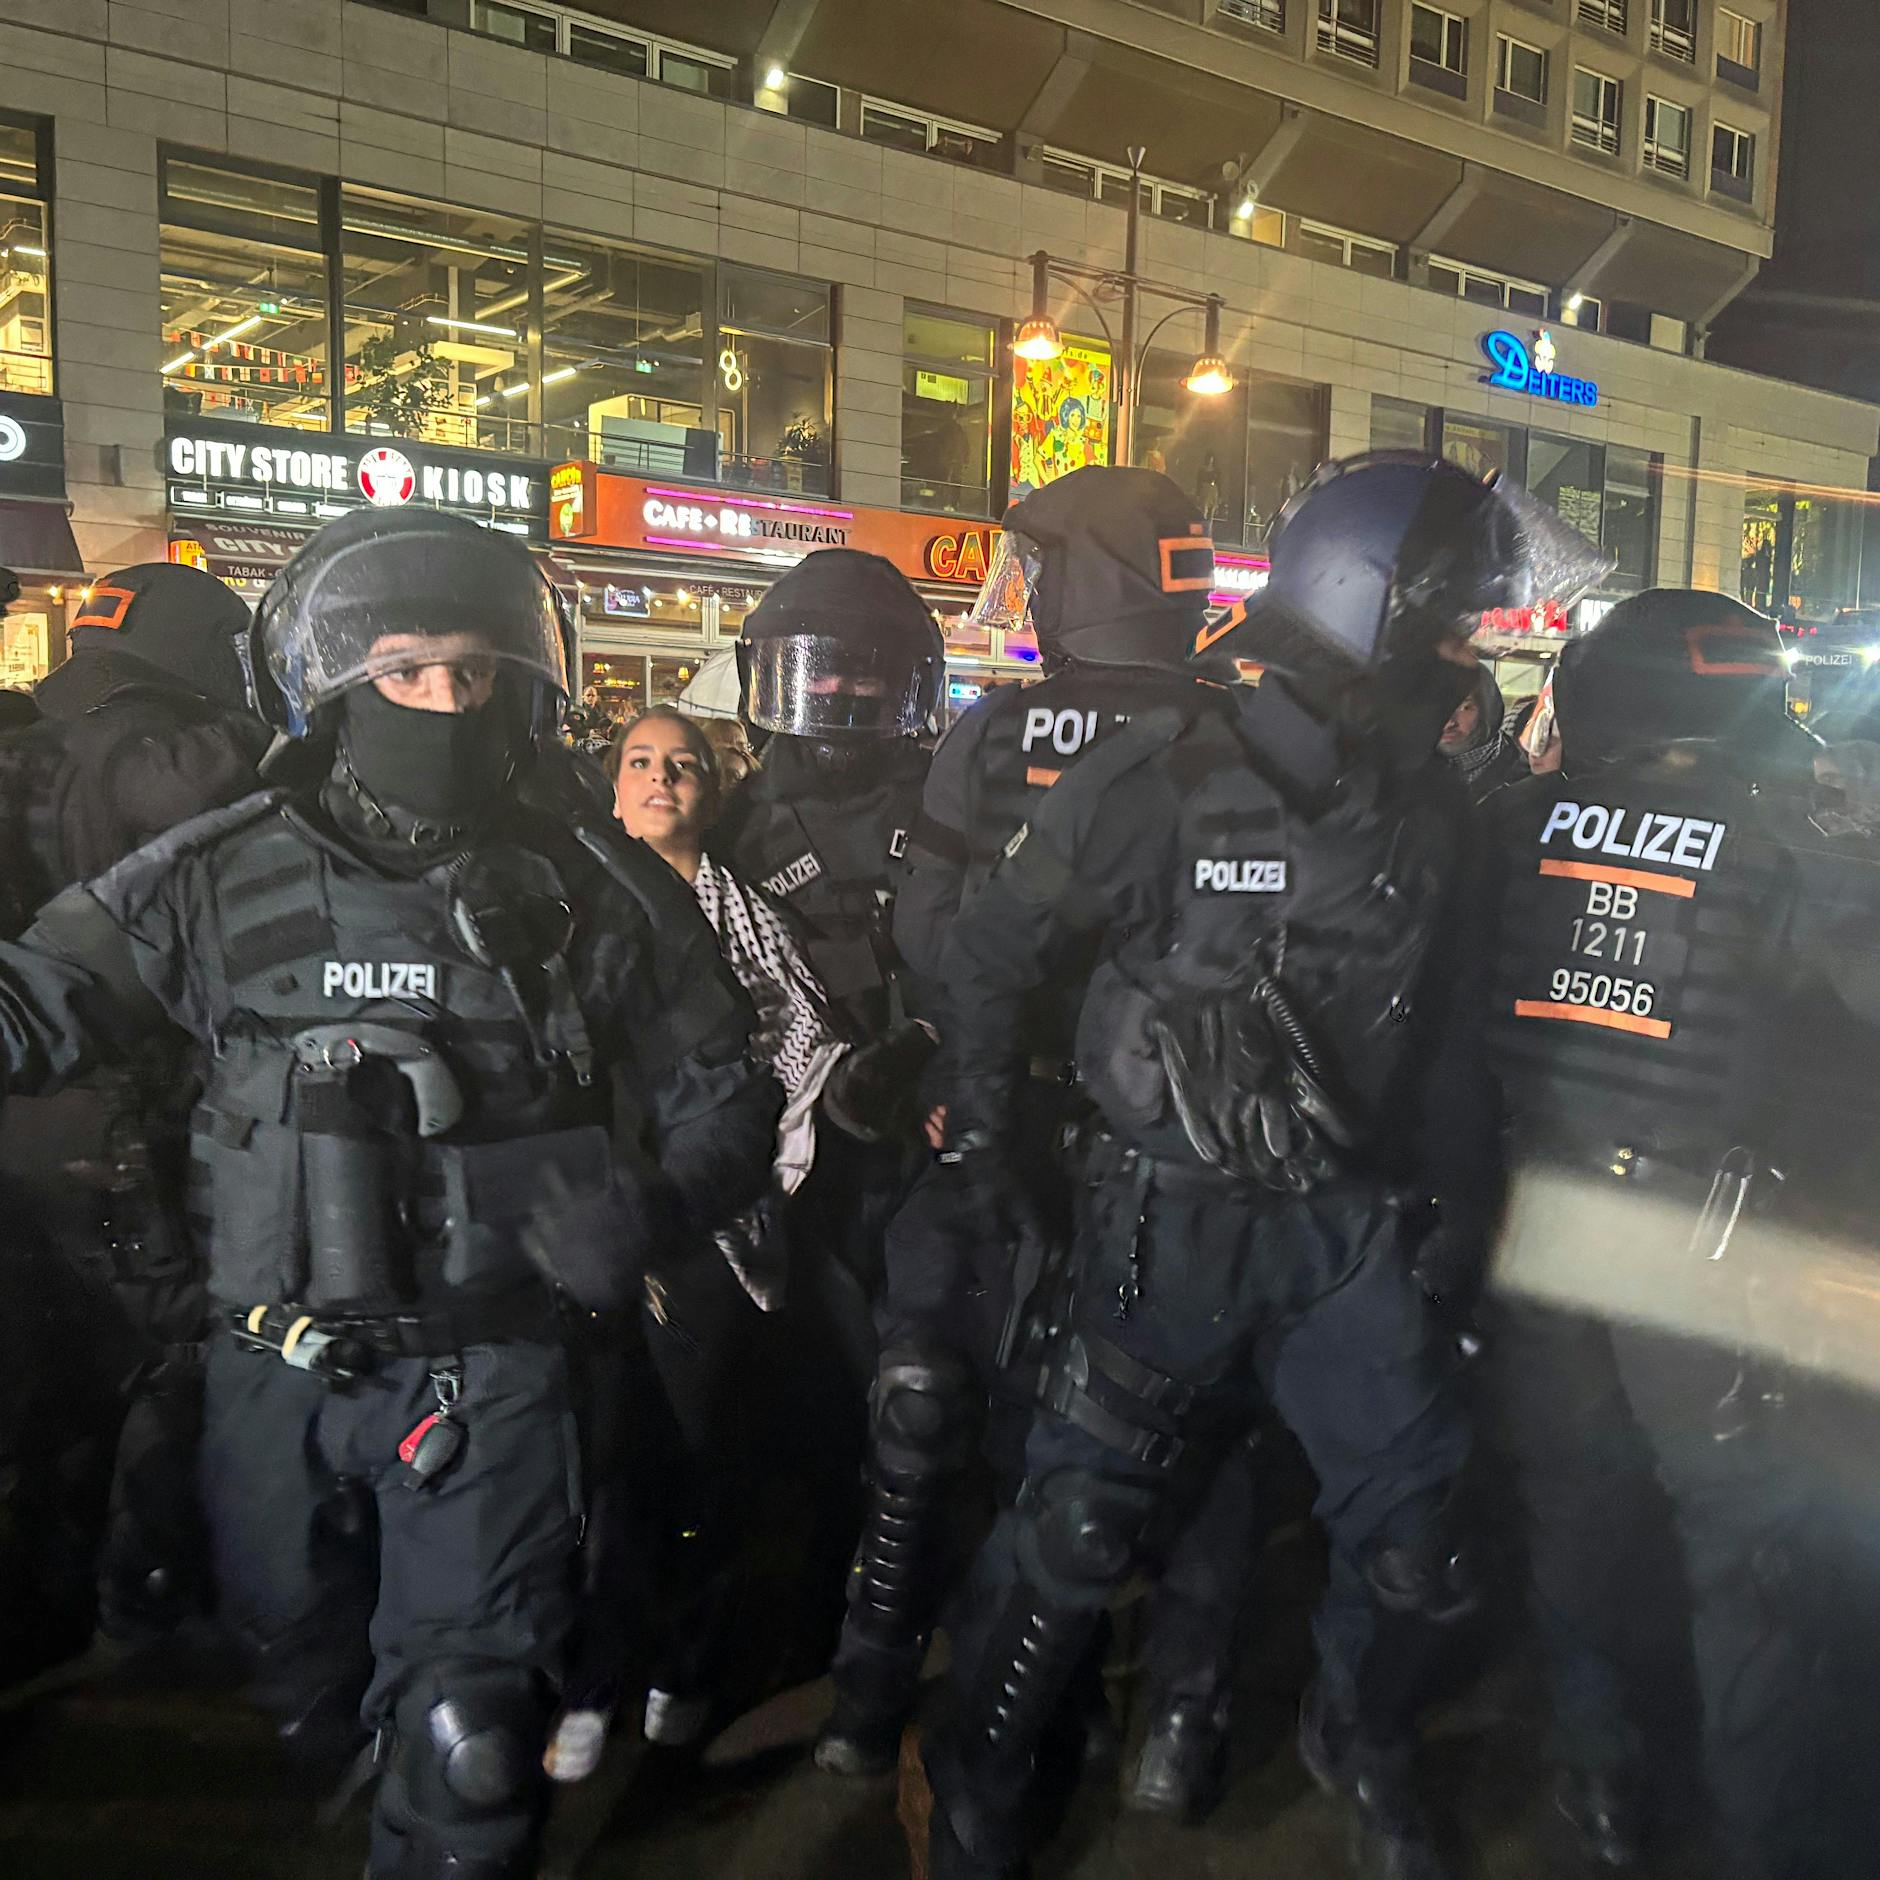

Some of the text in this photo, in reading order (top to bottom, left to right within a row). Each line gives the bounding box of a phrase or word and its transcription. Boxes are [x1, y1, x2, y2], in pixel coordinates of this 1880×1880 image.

[171, 437, 246, 478] CITY
[251, 446, 348, 490] STORE
[423, 465, 531, 509] KIOSK
[719, 509, 852, 545] RESTAURANT
[213, 537, 284, 556] CITY
[228, 566, 266, 578] TABAK
[689, 584, 714, 596] CAFÉ
[1805, 654, 1852, 666] POLIZEI
[1540, 801, 1726, 871] POLIZEI
[1195, 859, 1286, 892] POLIZEI
[1586, 881, 1639, 921] BB
[1570, 917, 1647, 966] 1211
[323, 961, 436, 999] POLIZEI
[1549, 968, 1655, 1017] 95056
